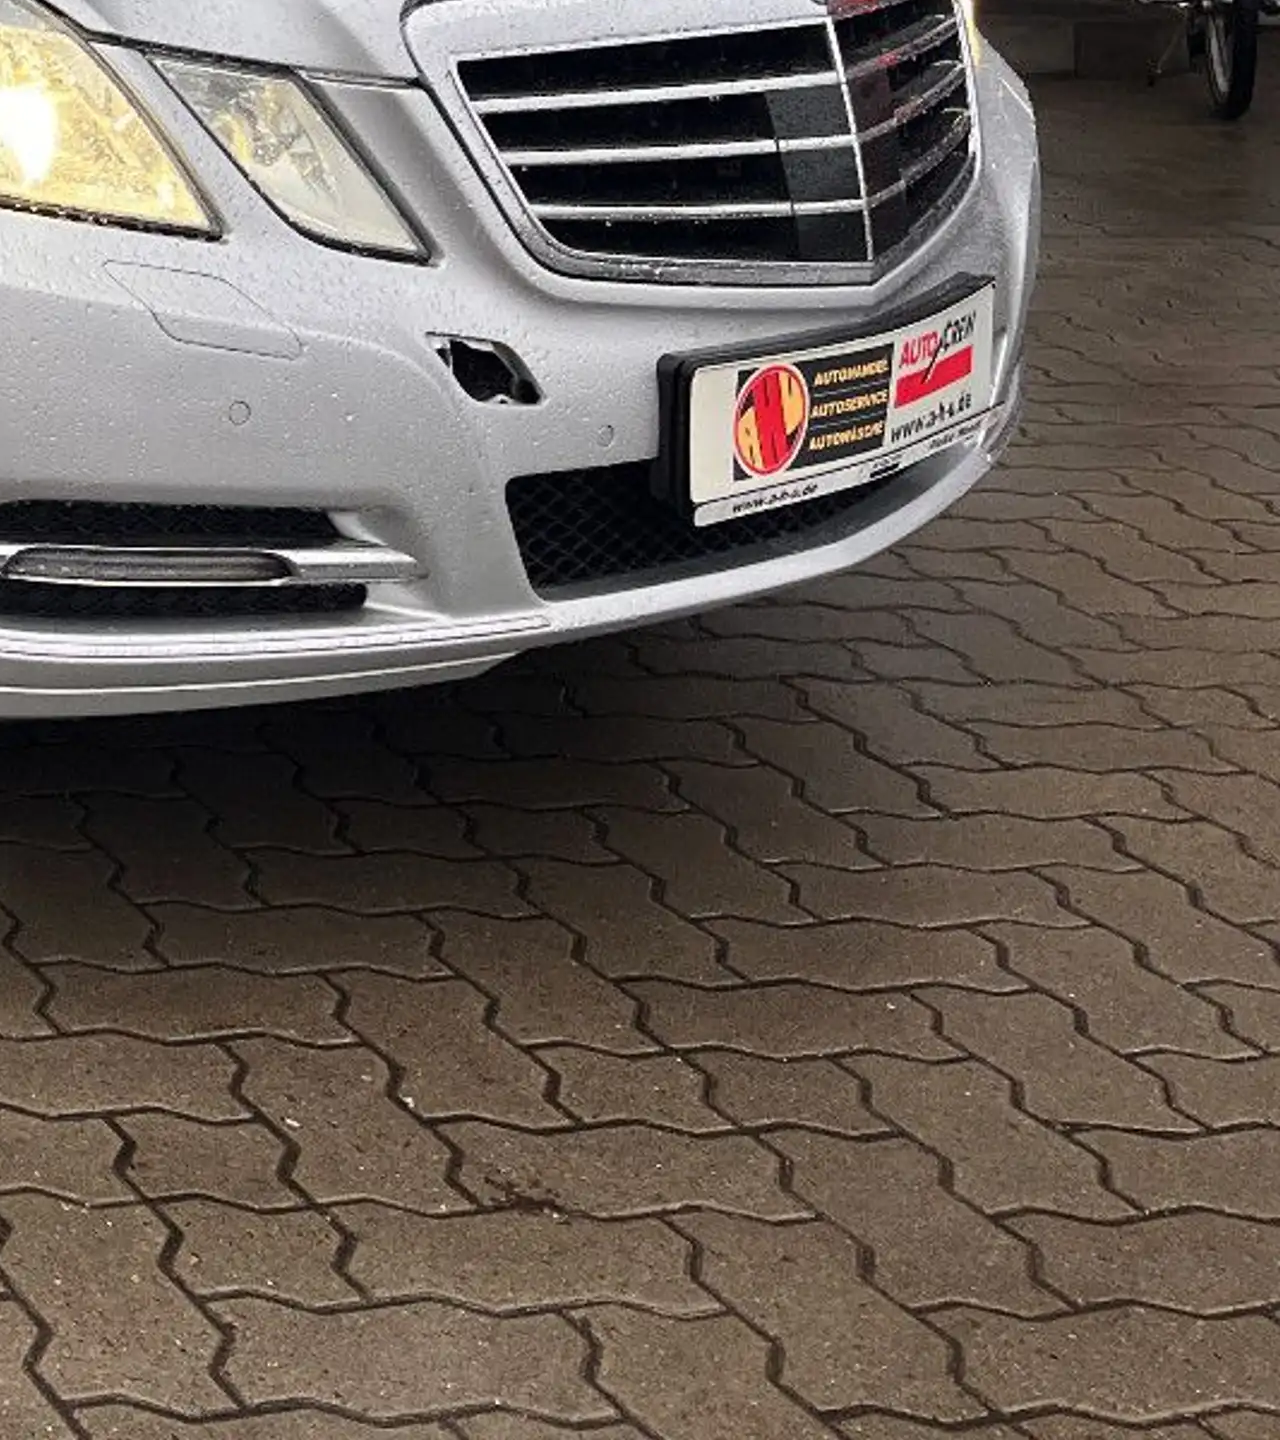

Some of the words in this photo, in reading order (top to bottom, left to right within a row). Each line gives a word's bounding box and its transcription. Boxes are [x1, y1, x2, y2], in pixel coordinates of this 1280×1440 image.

[899, 329, 940, 369] AUTO
[813, 358, 890, 387] AUTOHANDEL
[810, 389, 889, 418] AUTOSERVICE
